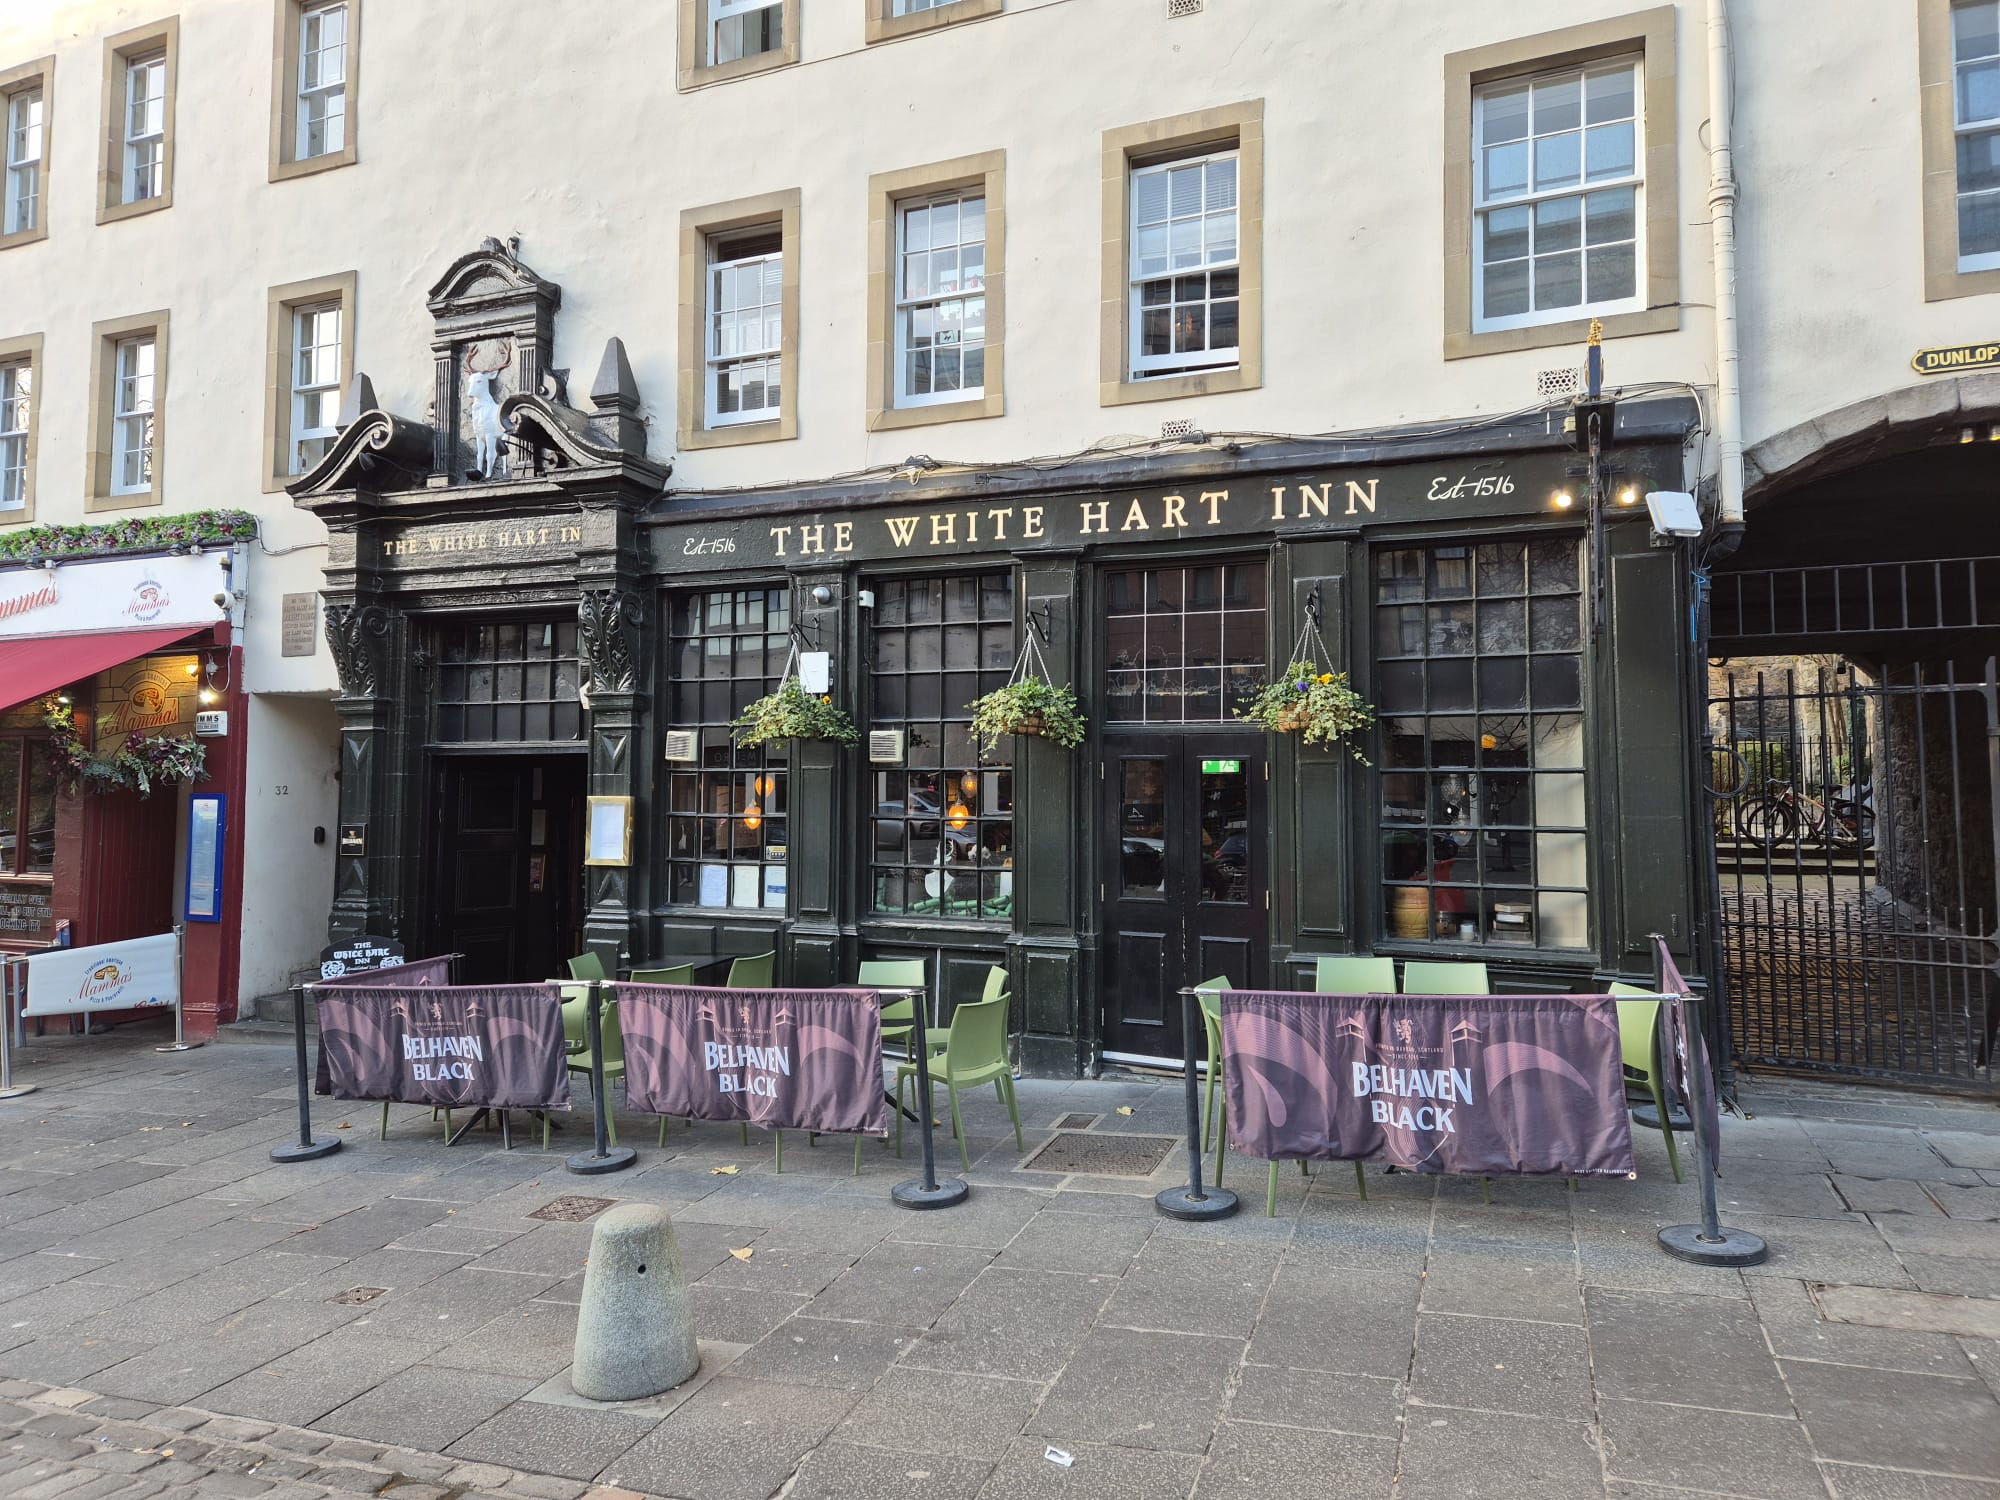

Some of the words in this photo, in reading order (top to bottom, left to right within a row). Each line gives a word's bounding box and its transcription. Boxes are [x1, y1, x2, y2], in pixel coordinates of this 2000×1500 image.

[1473, 474, 1515, 496] 1516
[770, 521, 854, 557] THE
[885, 506, 1045, 548] WHITE
[1079, 489, 1228, 534] HART
[1271, 478, 1379, 521] INN
[383, 539, 417, 556] THE
[428, 533, 488, 552] WHITE
[499, 528, 549, 547] HART
[561, 526, 582, 543] IN
[711, 536, 736, 554] 1516
[275, 785, 289, 796] 32
[353, 941, 372, 950] THE
[354, 957, 371, 965] INN
[68, 966, 132, 1003] Mamma's
[402, 1033, 483, 1062] BELHAVEN
[704, 1041, 791, 1077] BELHAVEN
[412, 1062, 476, 1082] BLACK
[719, 1073, 778, 1098] BLACK
[1352, 1061, 1474, 1106] BELHAVEN
[1371, 1099, 1456, 1133] BLACK
